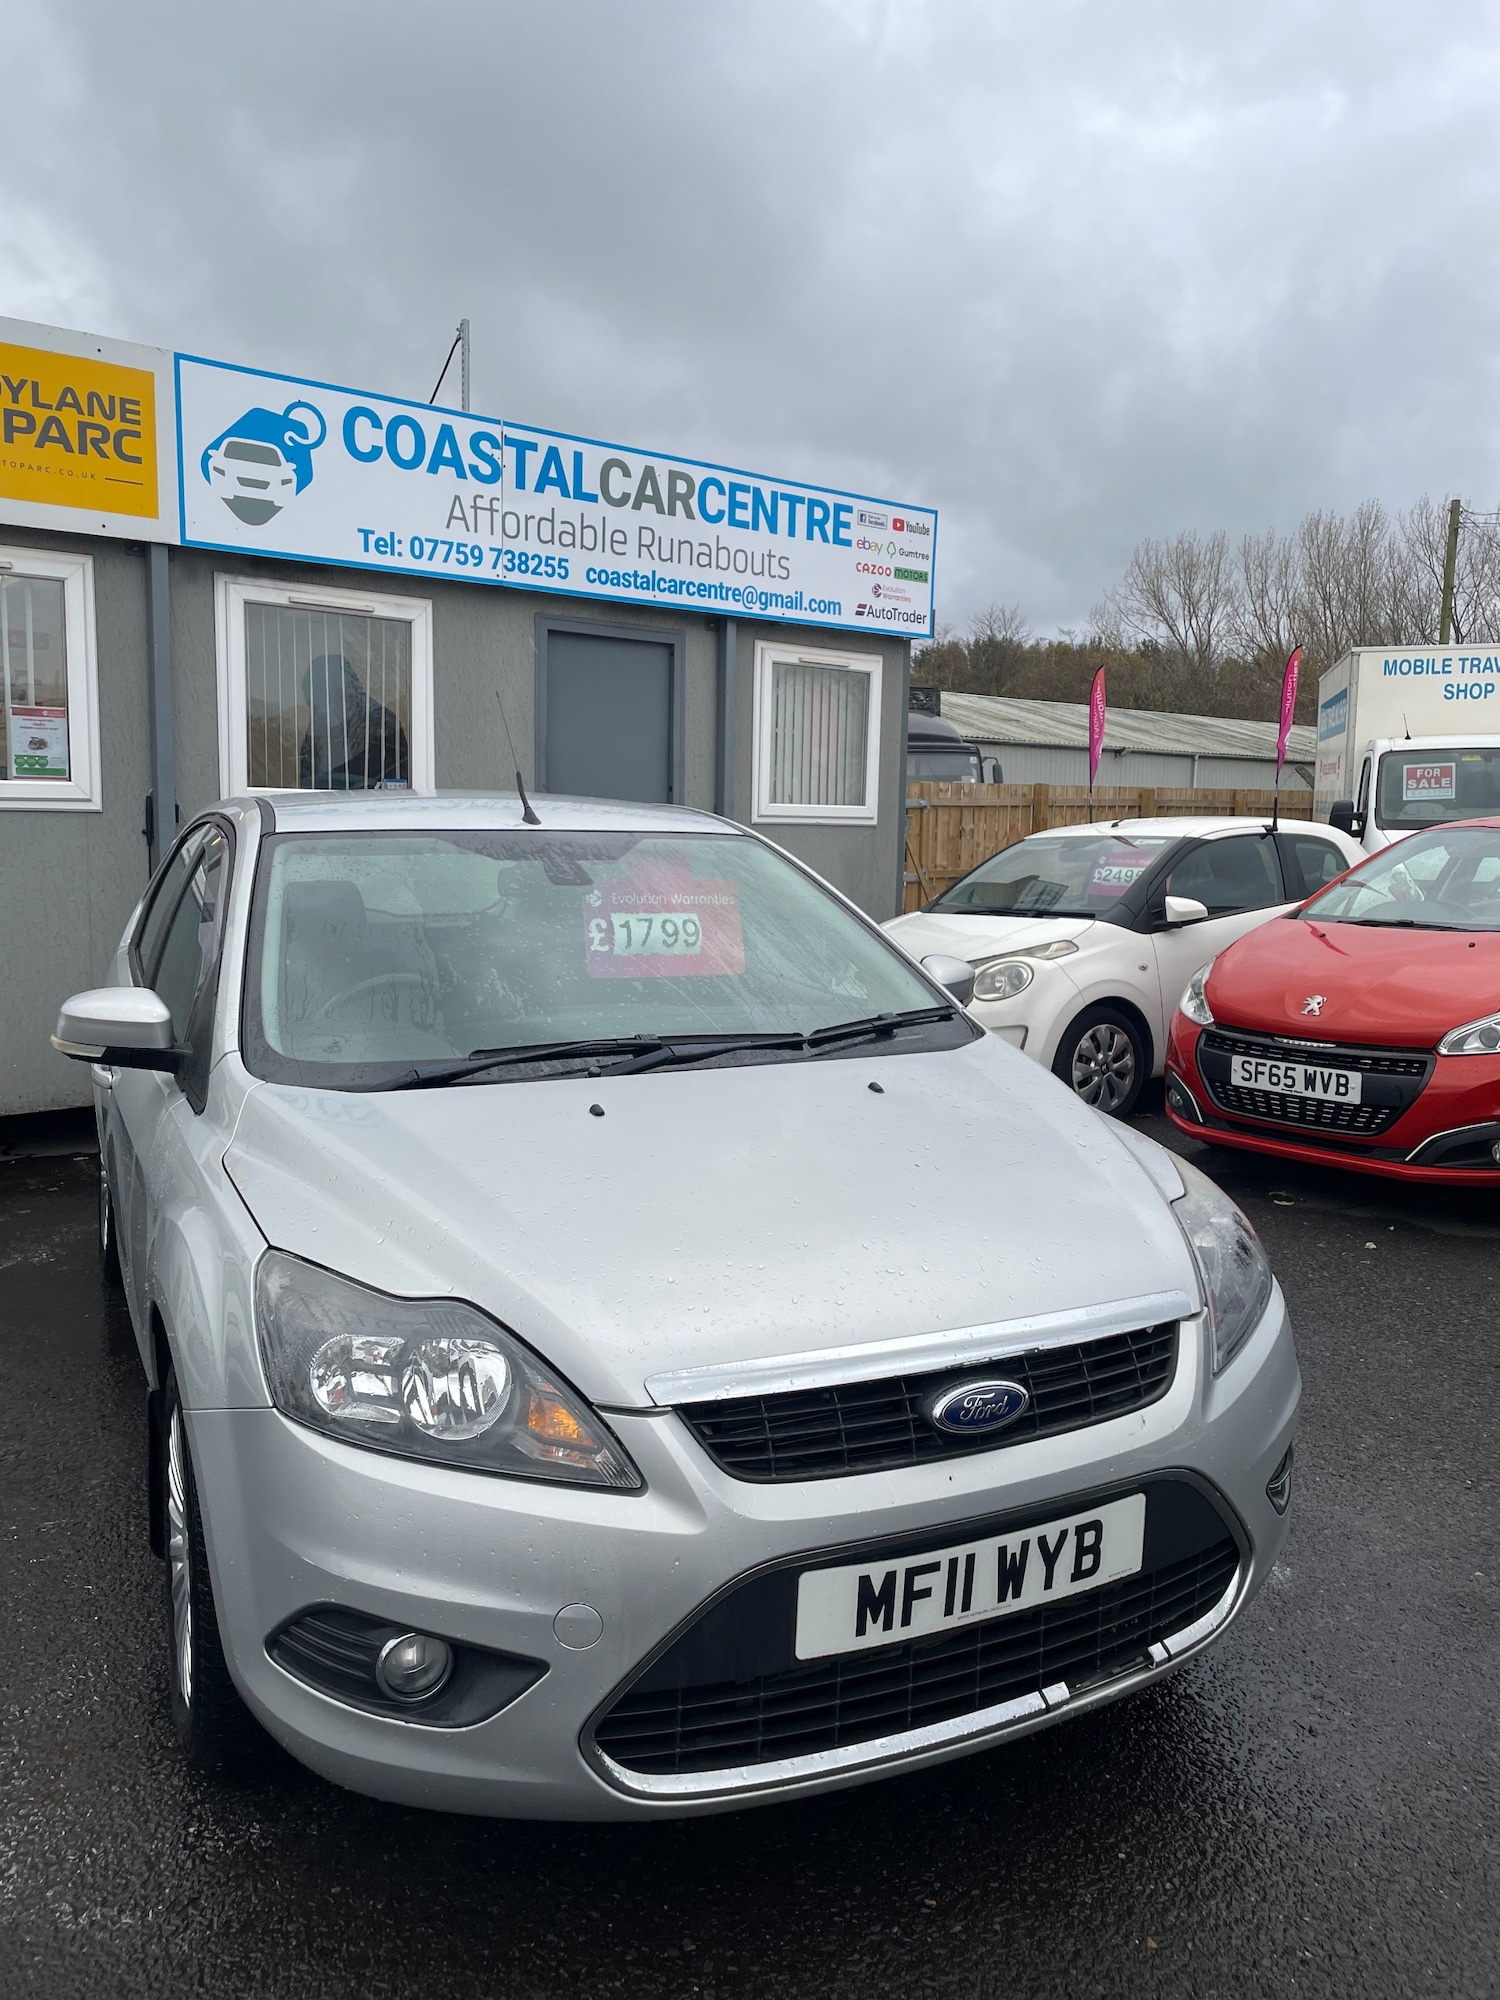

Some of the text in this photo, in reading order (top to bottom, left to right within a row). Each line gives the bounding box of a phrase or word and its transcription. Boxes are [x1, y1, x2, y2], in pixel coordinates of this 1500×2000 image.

[0, 374, 141, 425] YLANE
[445, 494, 790, 581] Affordable Runabouts
[905, 520, 930, 536] YouTube
[856, 536, 883, 555] ebay
[898, 547, 930, 561] Gumtree
[357, 527, 842, 617] Tel: 07759 738255 coastalcarcentre@gmail.com
[866, 604, 927, 624] AutoTrader
[1383, 657, 1453, 677] MOBILE
[1443, 682, 1496, 700] SHOP
[1407, 777, 1451, 789] SALE
[1416, 768, 1441, 778] FOR
[612, 892, 736, 905] Evolution Warranties
[1240, 1059, 1350, 1097] SF65 WVB
[959, 1392, 1009, 1421] Ford
[855, 1518, 1104, 1638] MF11 WYB
